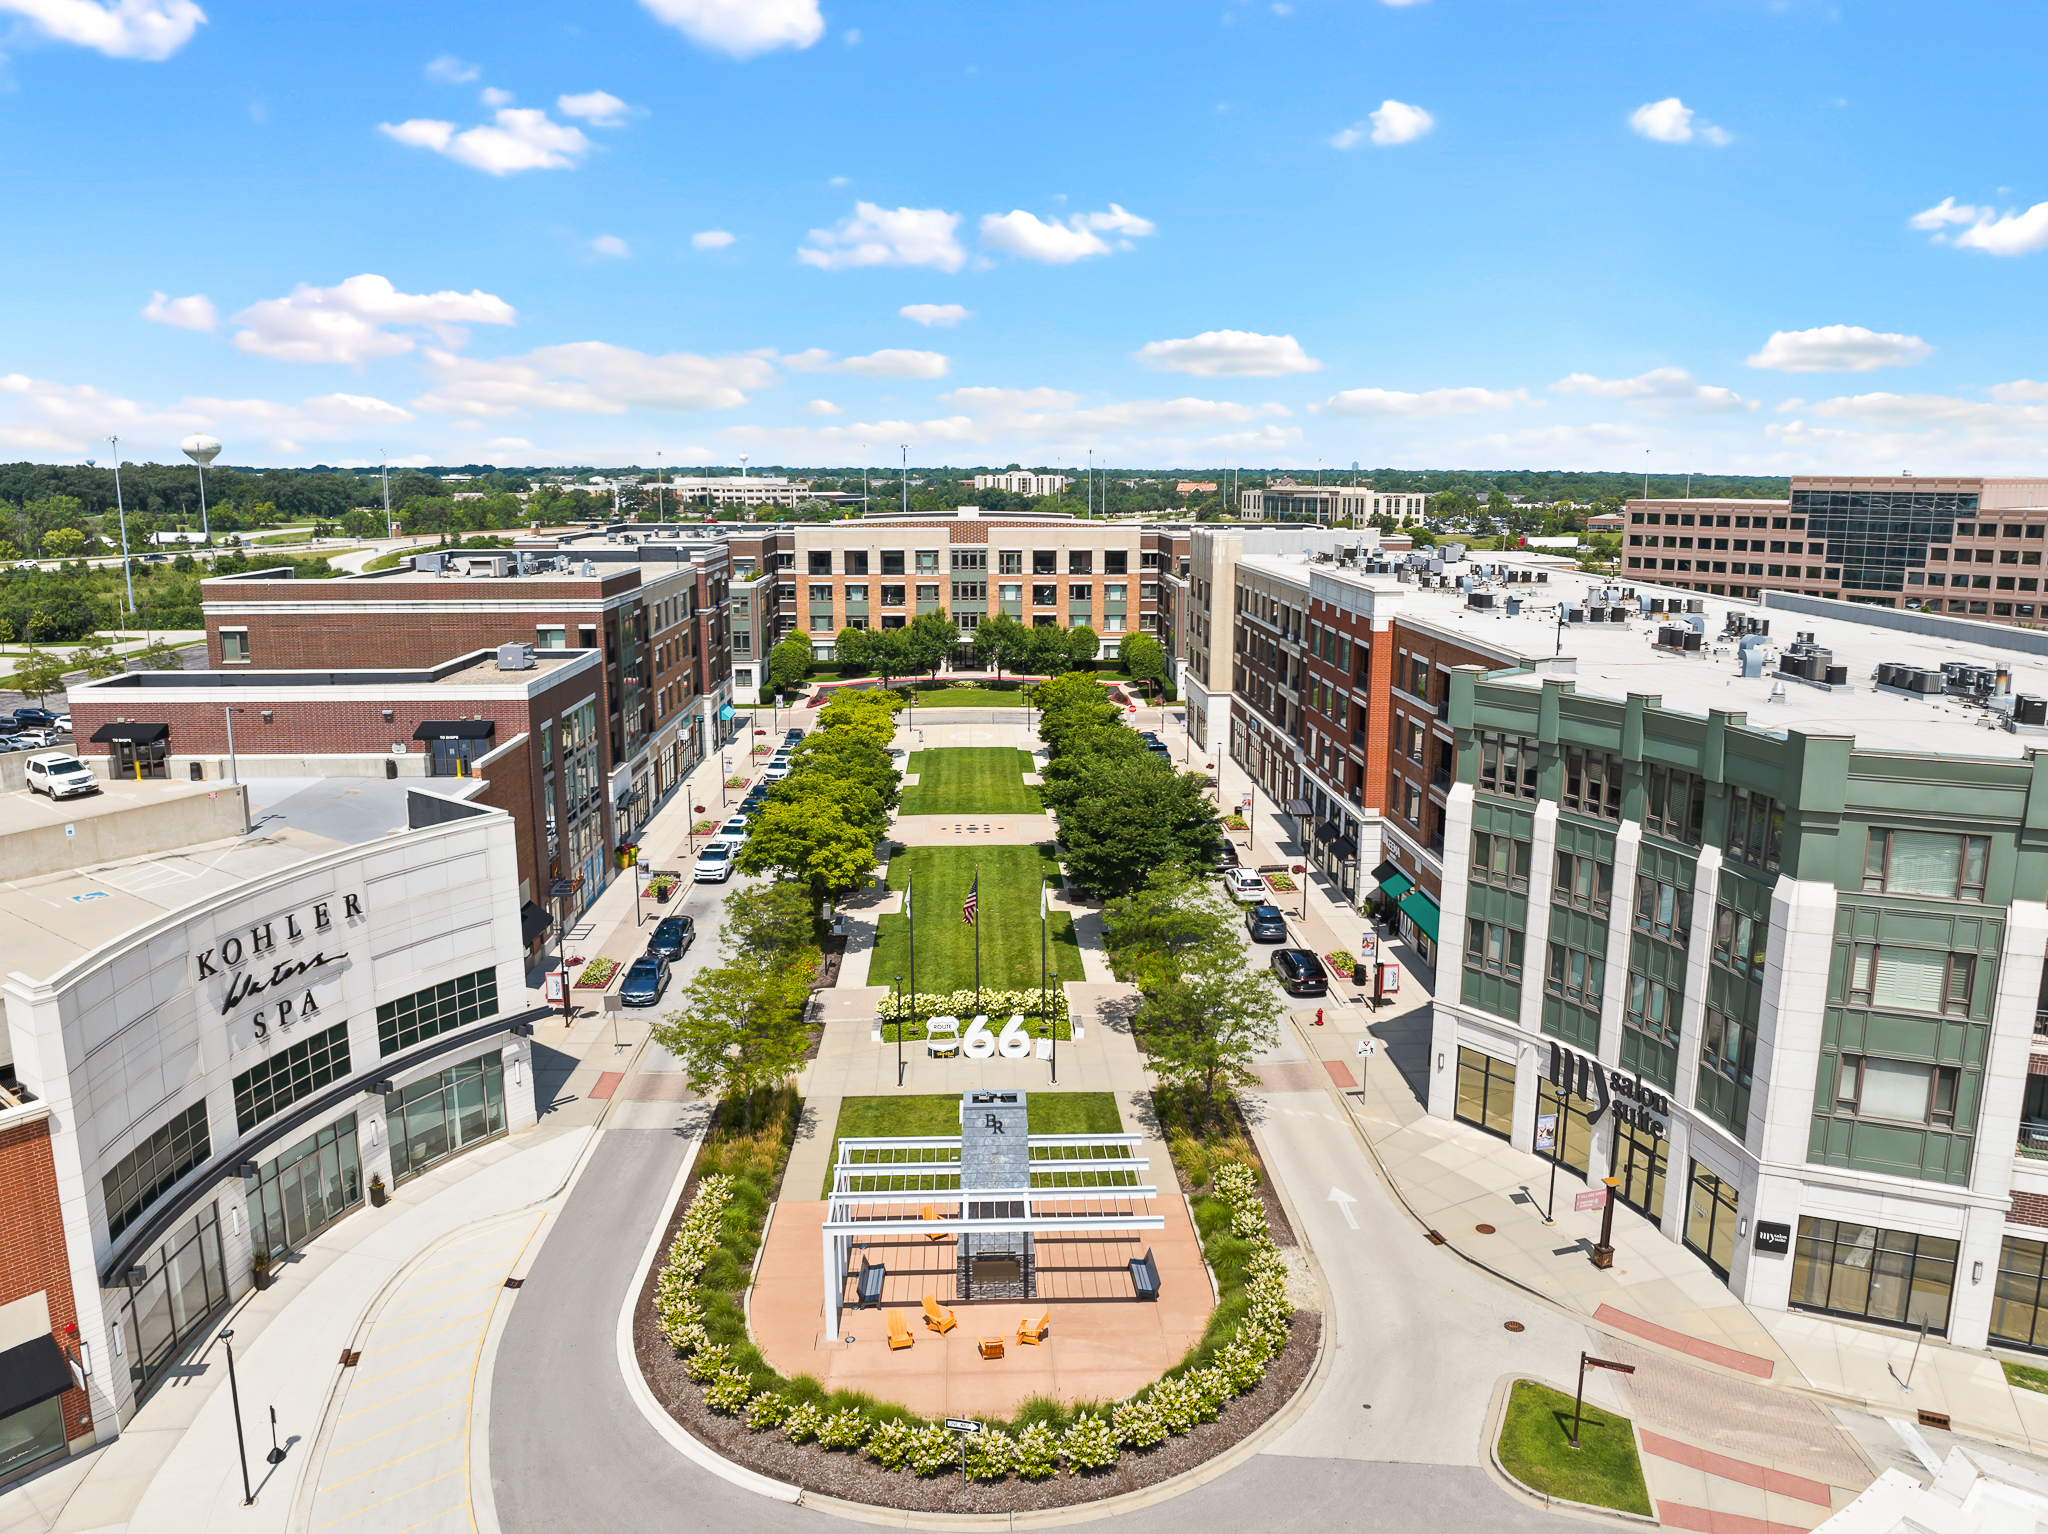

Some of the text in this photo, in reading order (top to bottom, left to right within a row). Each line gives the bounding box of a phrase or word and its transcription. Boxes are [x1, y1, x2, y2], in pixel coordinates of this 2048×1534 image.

[196, 894, 362, 981] KOHLER
[253, 988, 319, 1038] SPA
[963, 1015, 1030, 1058] 66
[1548, 1041, 1610, 1126] my
[1610, 1072, 1669, 1117] salon
[1612, 1100, 1664, 1140] suite
[1760, 1232, 1774, 1244] my
